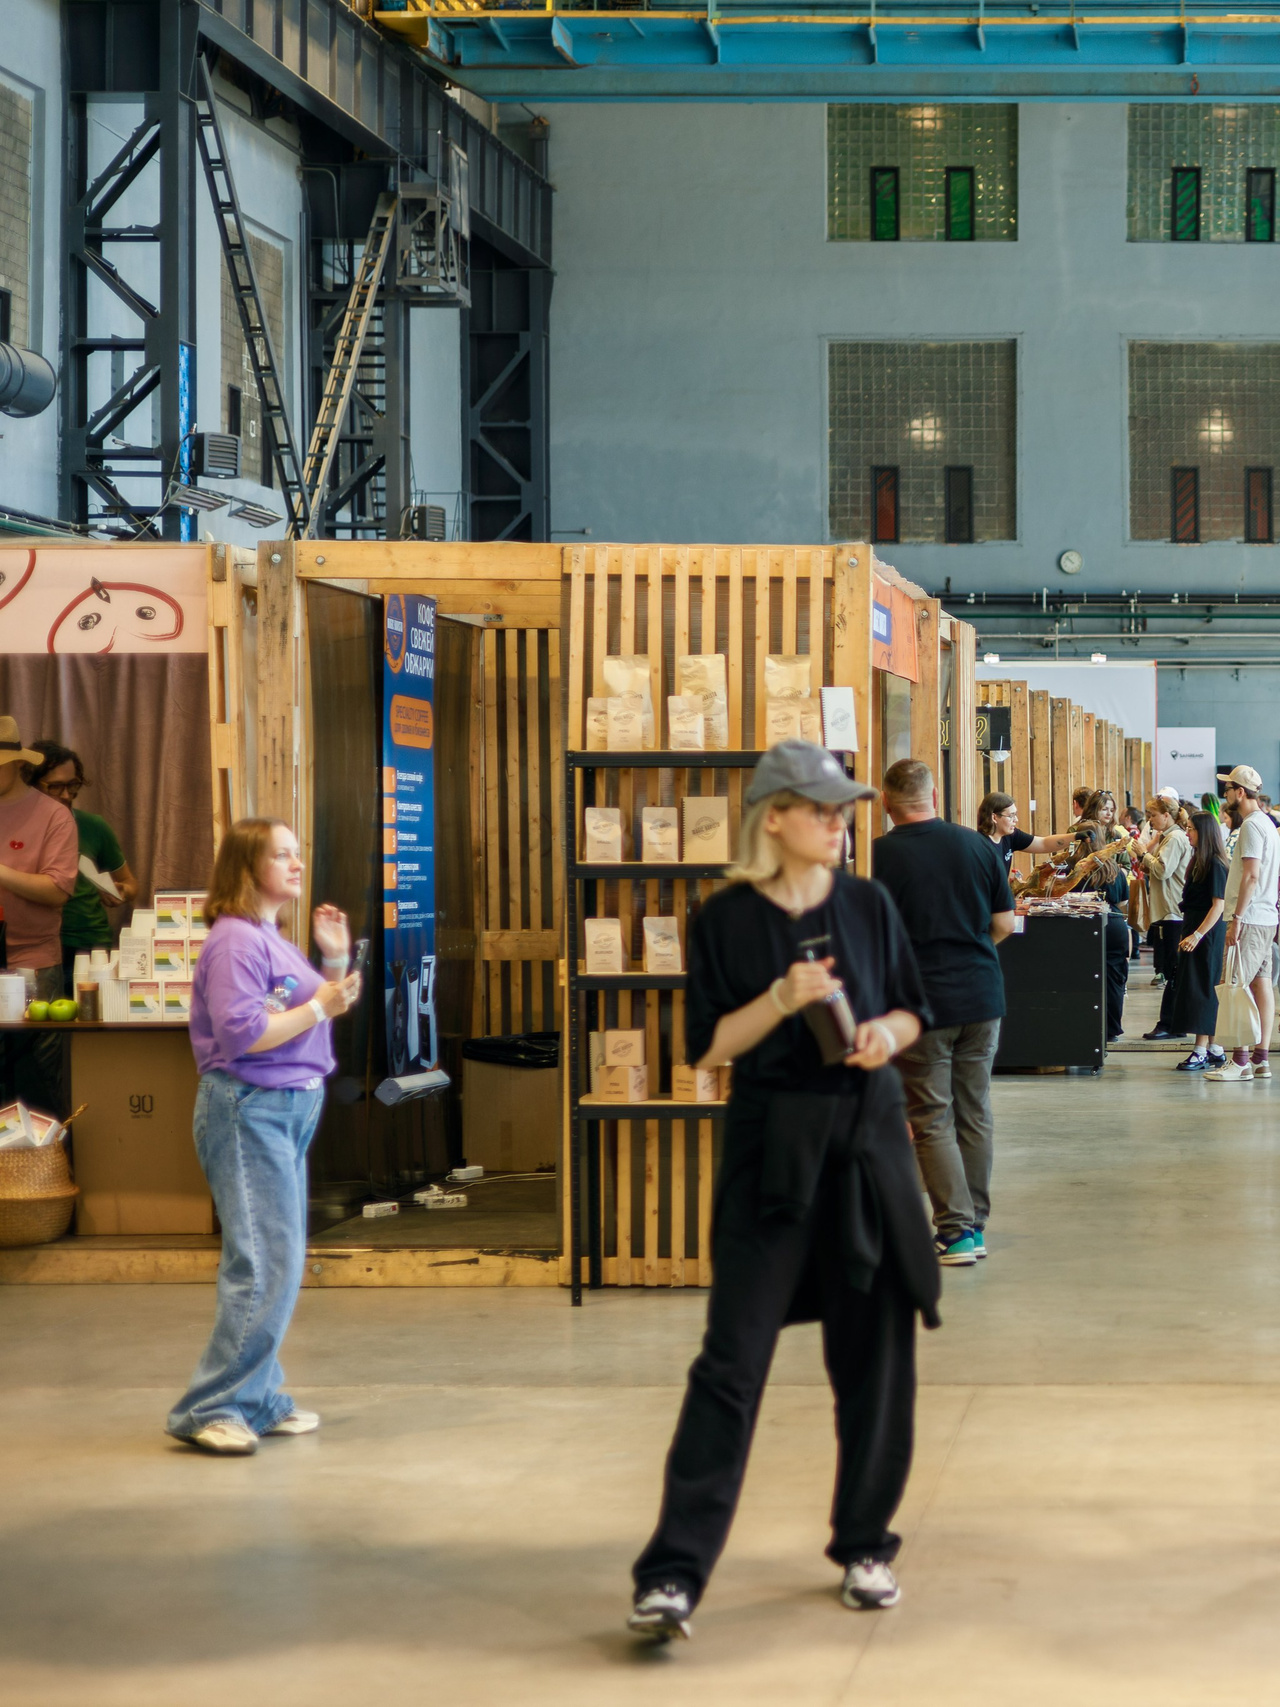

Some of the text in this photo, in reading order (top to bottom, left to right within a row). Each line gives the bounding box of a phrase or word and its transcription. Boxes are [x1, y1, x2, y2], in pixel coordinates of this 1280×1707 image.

[417, 602, 434, 627] КОФЕ
[410, 627, 434, 653] СВЕЖЕЙ
[404, 652, 434, 679] ОБЖАРКИ
[129, 1094, 154, 1114] 90
